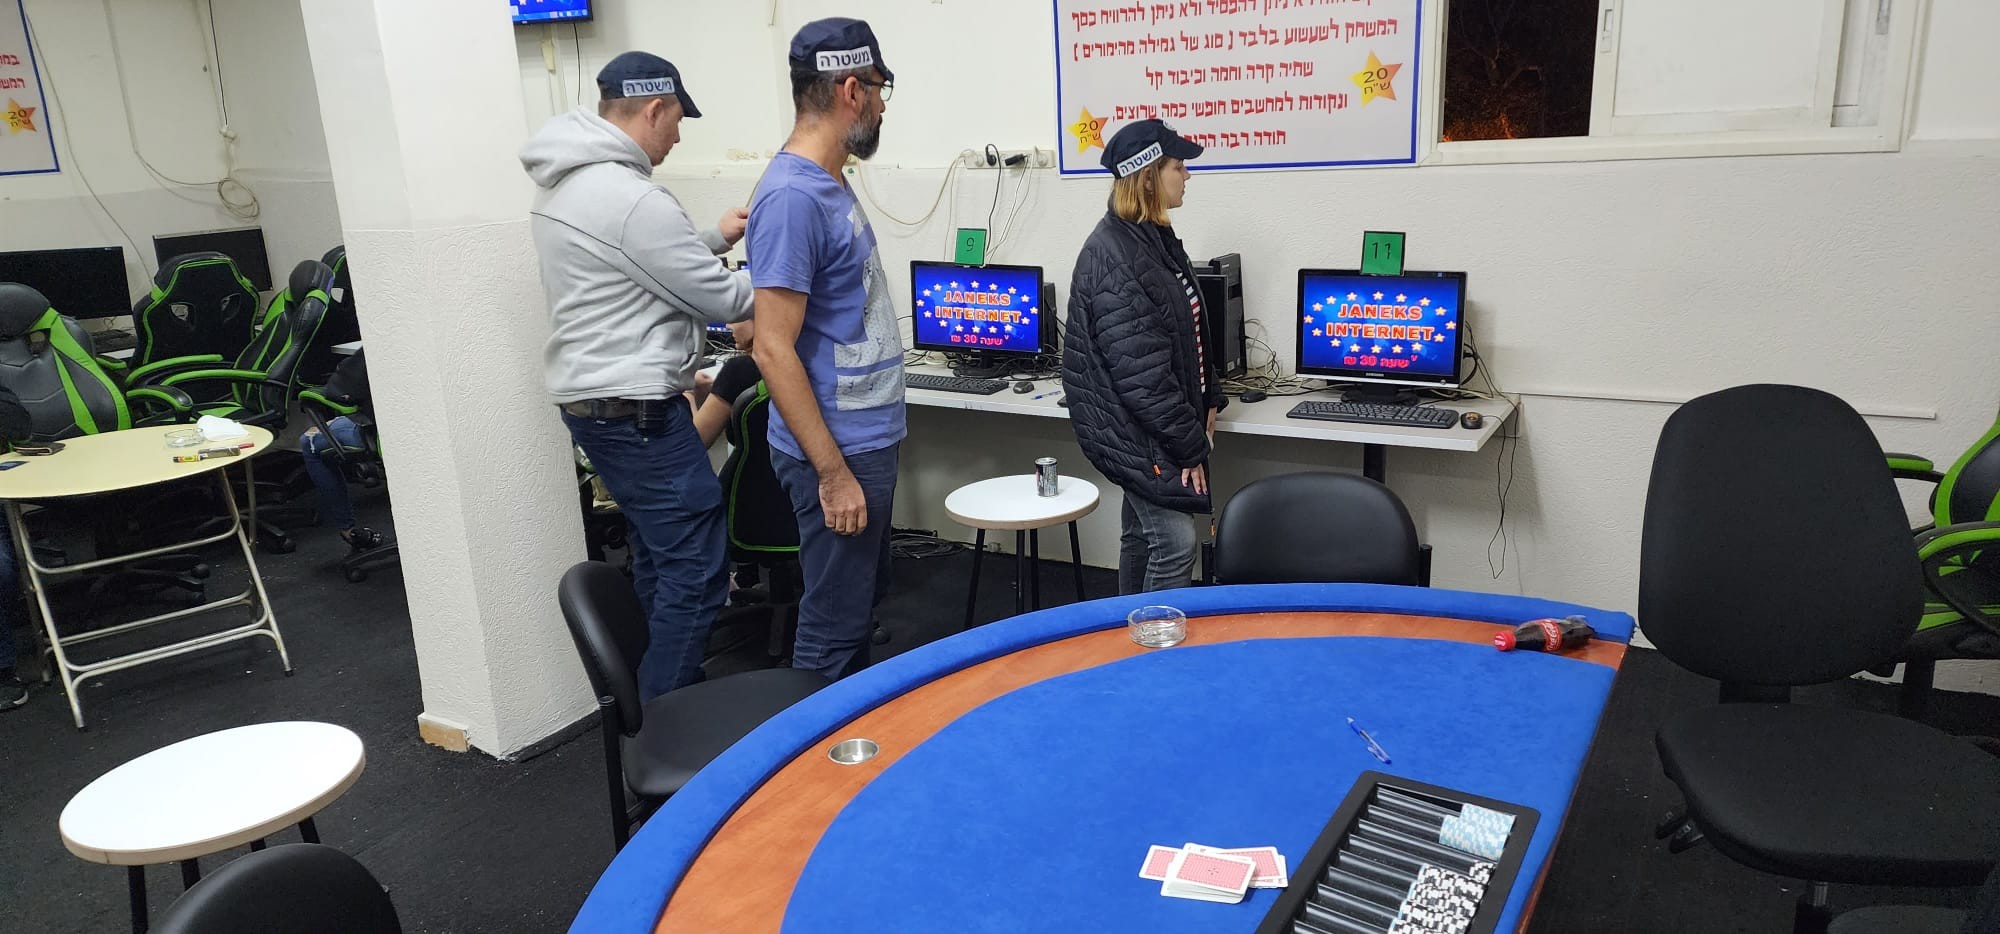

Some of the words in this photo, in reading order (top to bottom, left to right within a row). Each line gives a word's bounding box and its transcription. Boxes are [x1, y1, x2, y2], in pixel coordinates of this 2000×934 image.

[1071, 11, 1097, 33] כסף
[1100, 1, 1145, 25] להרוויח
[1150, 3, 1175, 26] ניתן
[1238, 23, 1280, 47] בלבד
[1284, 17, 1340, 46] לשעשוע
[1344, 18, 1398, 44] המשחק
[1082, 40, 1135, 59] מהימורים
[1139, 33, 1176, 54] גמילה
[1180, 30, 1199, 51] של
[1203, 32, 1224, 50] סוג
[819, 50, 870, 68] משטרה
[1167, 68, 1206, 86] וכיבוד
[1211, 65, 1241, 82] וחמה
[1246, 63, 1274, 84] קרה
[1279, 60, 1314, 78] שתיה
[1363, 67, 1388, 84] 20
[624, 80, 672, 95] משטרה
[1145, 66, 1163, 91] קל
[1161, 102, 1187, 119] כמה
[1191, 100, 1226, 118] חופשי
[1230, 90, 1294, 115] למחשבים
[1298, 93, 1348, 114] ונקודות
[1079, 120, 1099, 134] 20
[1220, 131, 1249, 149] רבה
[1253, 130, 1286, 146] תודה
[1119, 146, 1160, 174] משטרה
[966, 237, 975, 252] 9
[1371, 242, 1391, 260] 11
[943, 290, 1011, 306] JANEKS
[934, 306, 1022, 323] INTERNET
[1337, 303, 1423, 320] JANEKS
[963, 334, 978, 344] 30
[1326, 322, 1435, 341] INTERNET
[1359, 354, 1377, 367] 30
